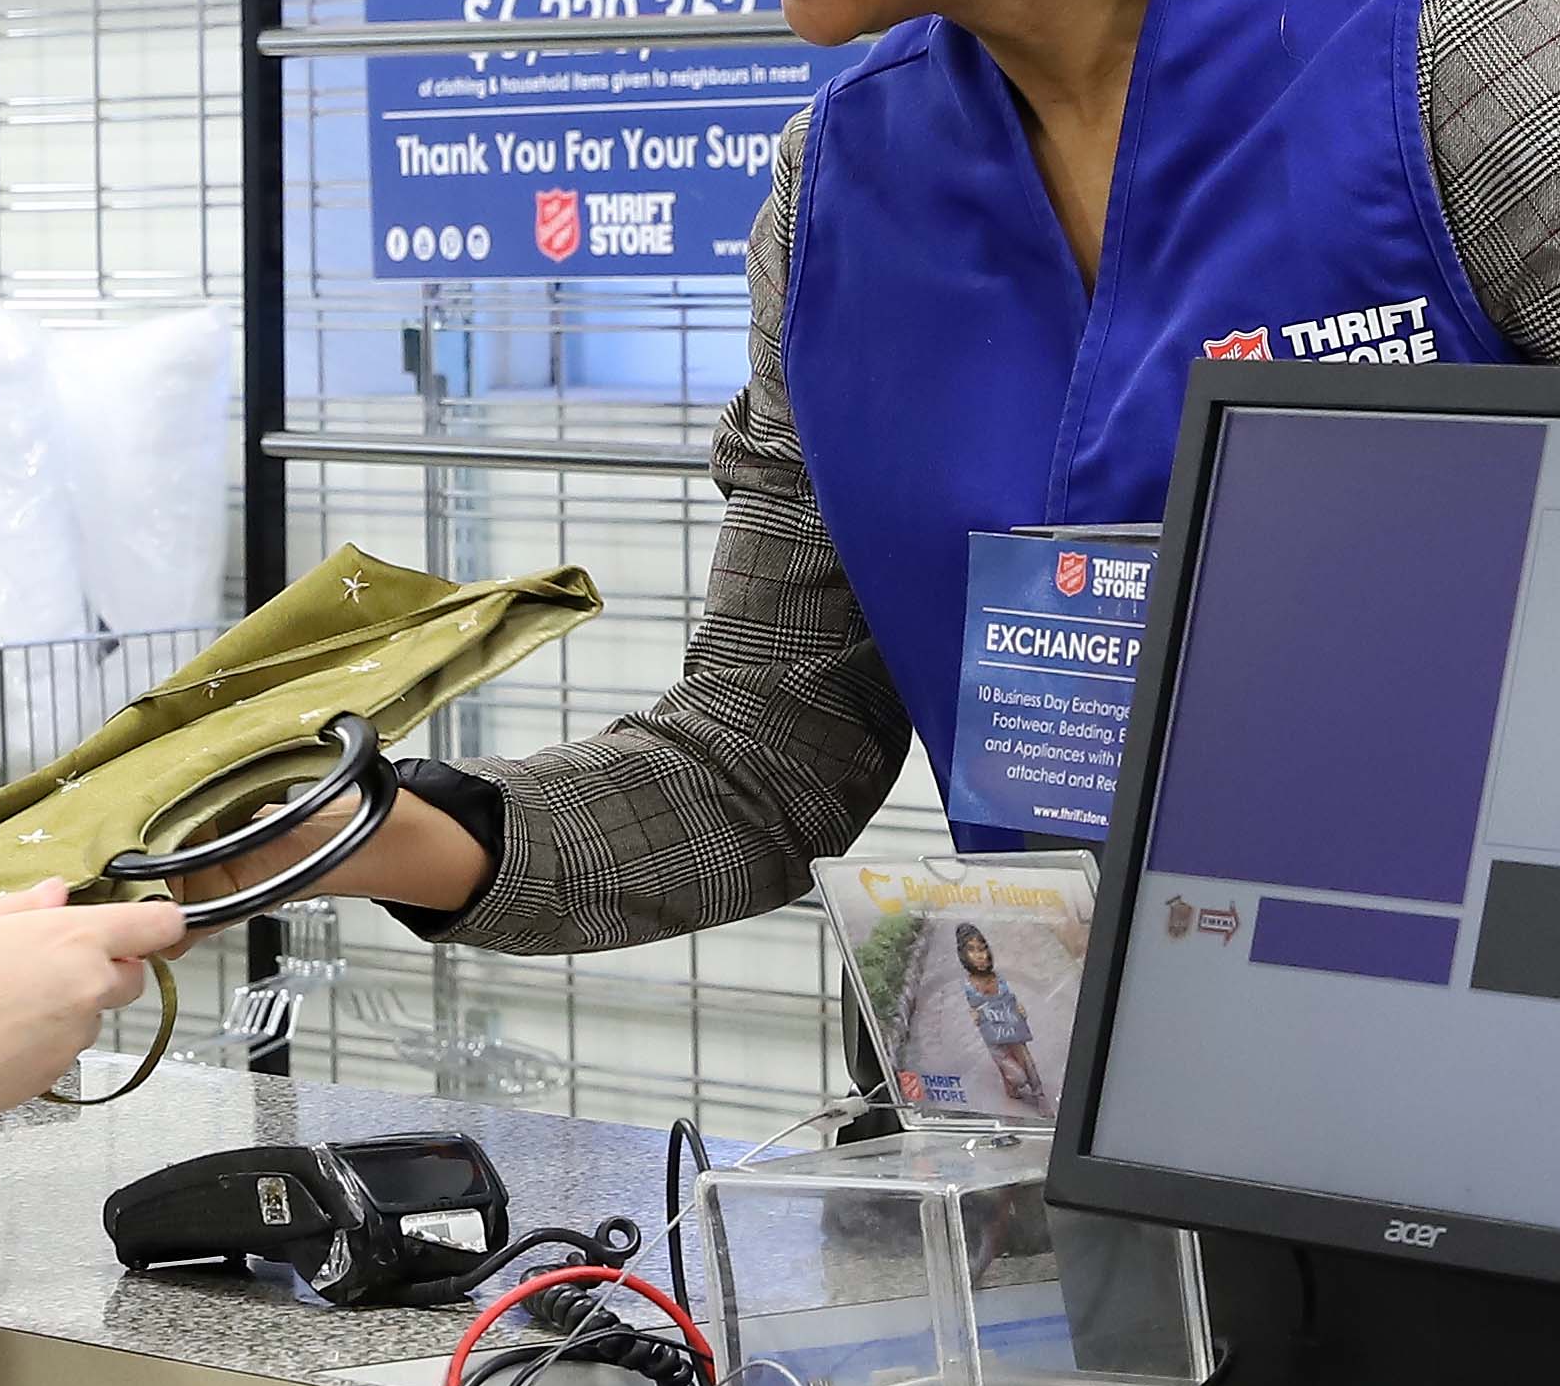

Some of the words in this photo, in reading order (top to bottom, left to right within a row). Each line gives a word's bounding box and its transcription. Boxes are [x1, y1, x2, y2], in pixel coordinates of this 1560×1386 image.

[434, 75, 487, 99] clothing
[500, 70, 570, 94] household
[573, 69, 609, 91] items
[611, 69, 651, 93] given
[653, 68, 668, 86] to
[670, 64, 751, 91] neighbours
[753, 63, 767, 83] in
[769, 61, 810, 83] need
[396, 135, 489, 176] Thank
[494, 132, 557, 173] You
[565, 129, 613, 171] For
[622, 128, 698, 170] Your
[586, 192, 676, 224] THRIFT
[588, 223, 674, 255] STORE
[1281, 296, 1428, 358] THRIFT
[1092, 558, 1151, 581] THRIFT
[1092, 578, 1147, 600] STORE
[985, 623, 1120, 664] EXCHANGE
[978, 684, 991, 702] 10
[992, 687, 1042, 708] Business
[1043, 693, 1071, 715] Day
[985, 738, 1011, 753] and
[1014, 740, 1086, 765] Appliances
[1087, 748, 1115, 766] with
[1006, 763, 1067, 786] attached
[1067, 770, 1094, 789] and
[921, 1074, 962, 1090] THRIFT
[926, 1088, 967, 1104] STORE
[1383, 1219, 1447, 1250] acer
